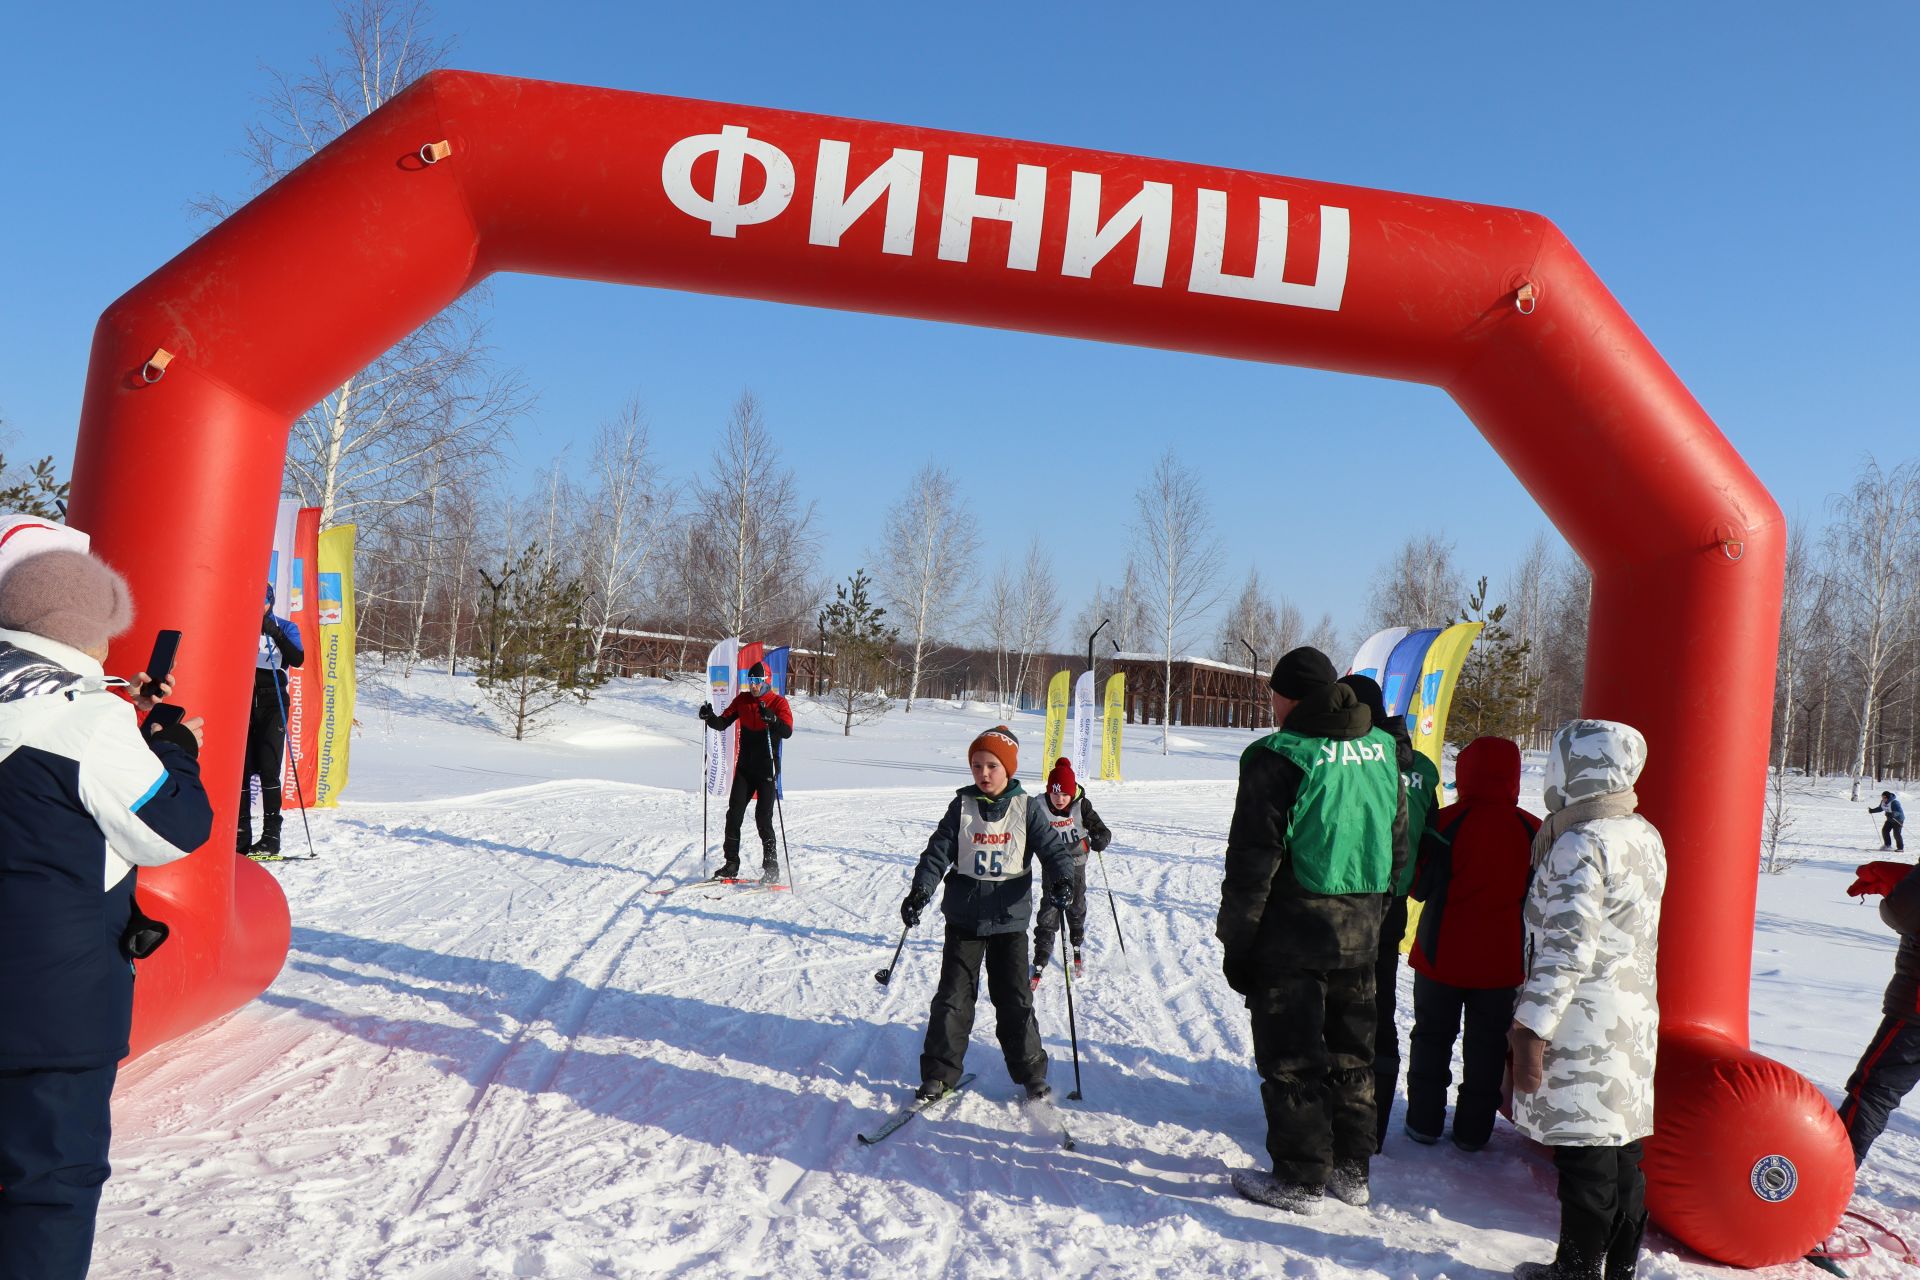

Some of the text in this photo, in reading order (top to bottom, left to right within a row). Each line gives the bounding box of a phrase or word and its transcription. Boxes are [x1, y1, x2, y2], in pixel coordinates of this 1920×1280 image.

[661, 124, 1350, 312] ФИНИШ
[317, 634, 339, 803] муниципальный район
[972, 832, 1012, 845] РСФСР
[974, 850, 1003, 877] 65
